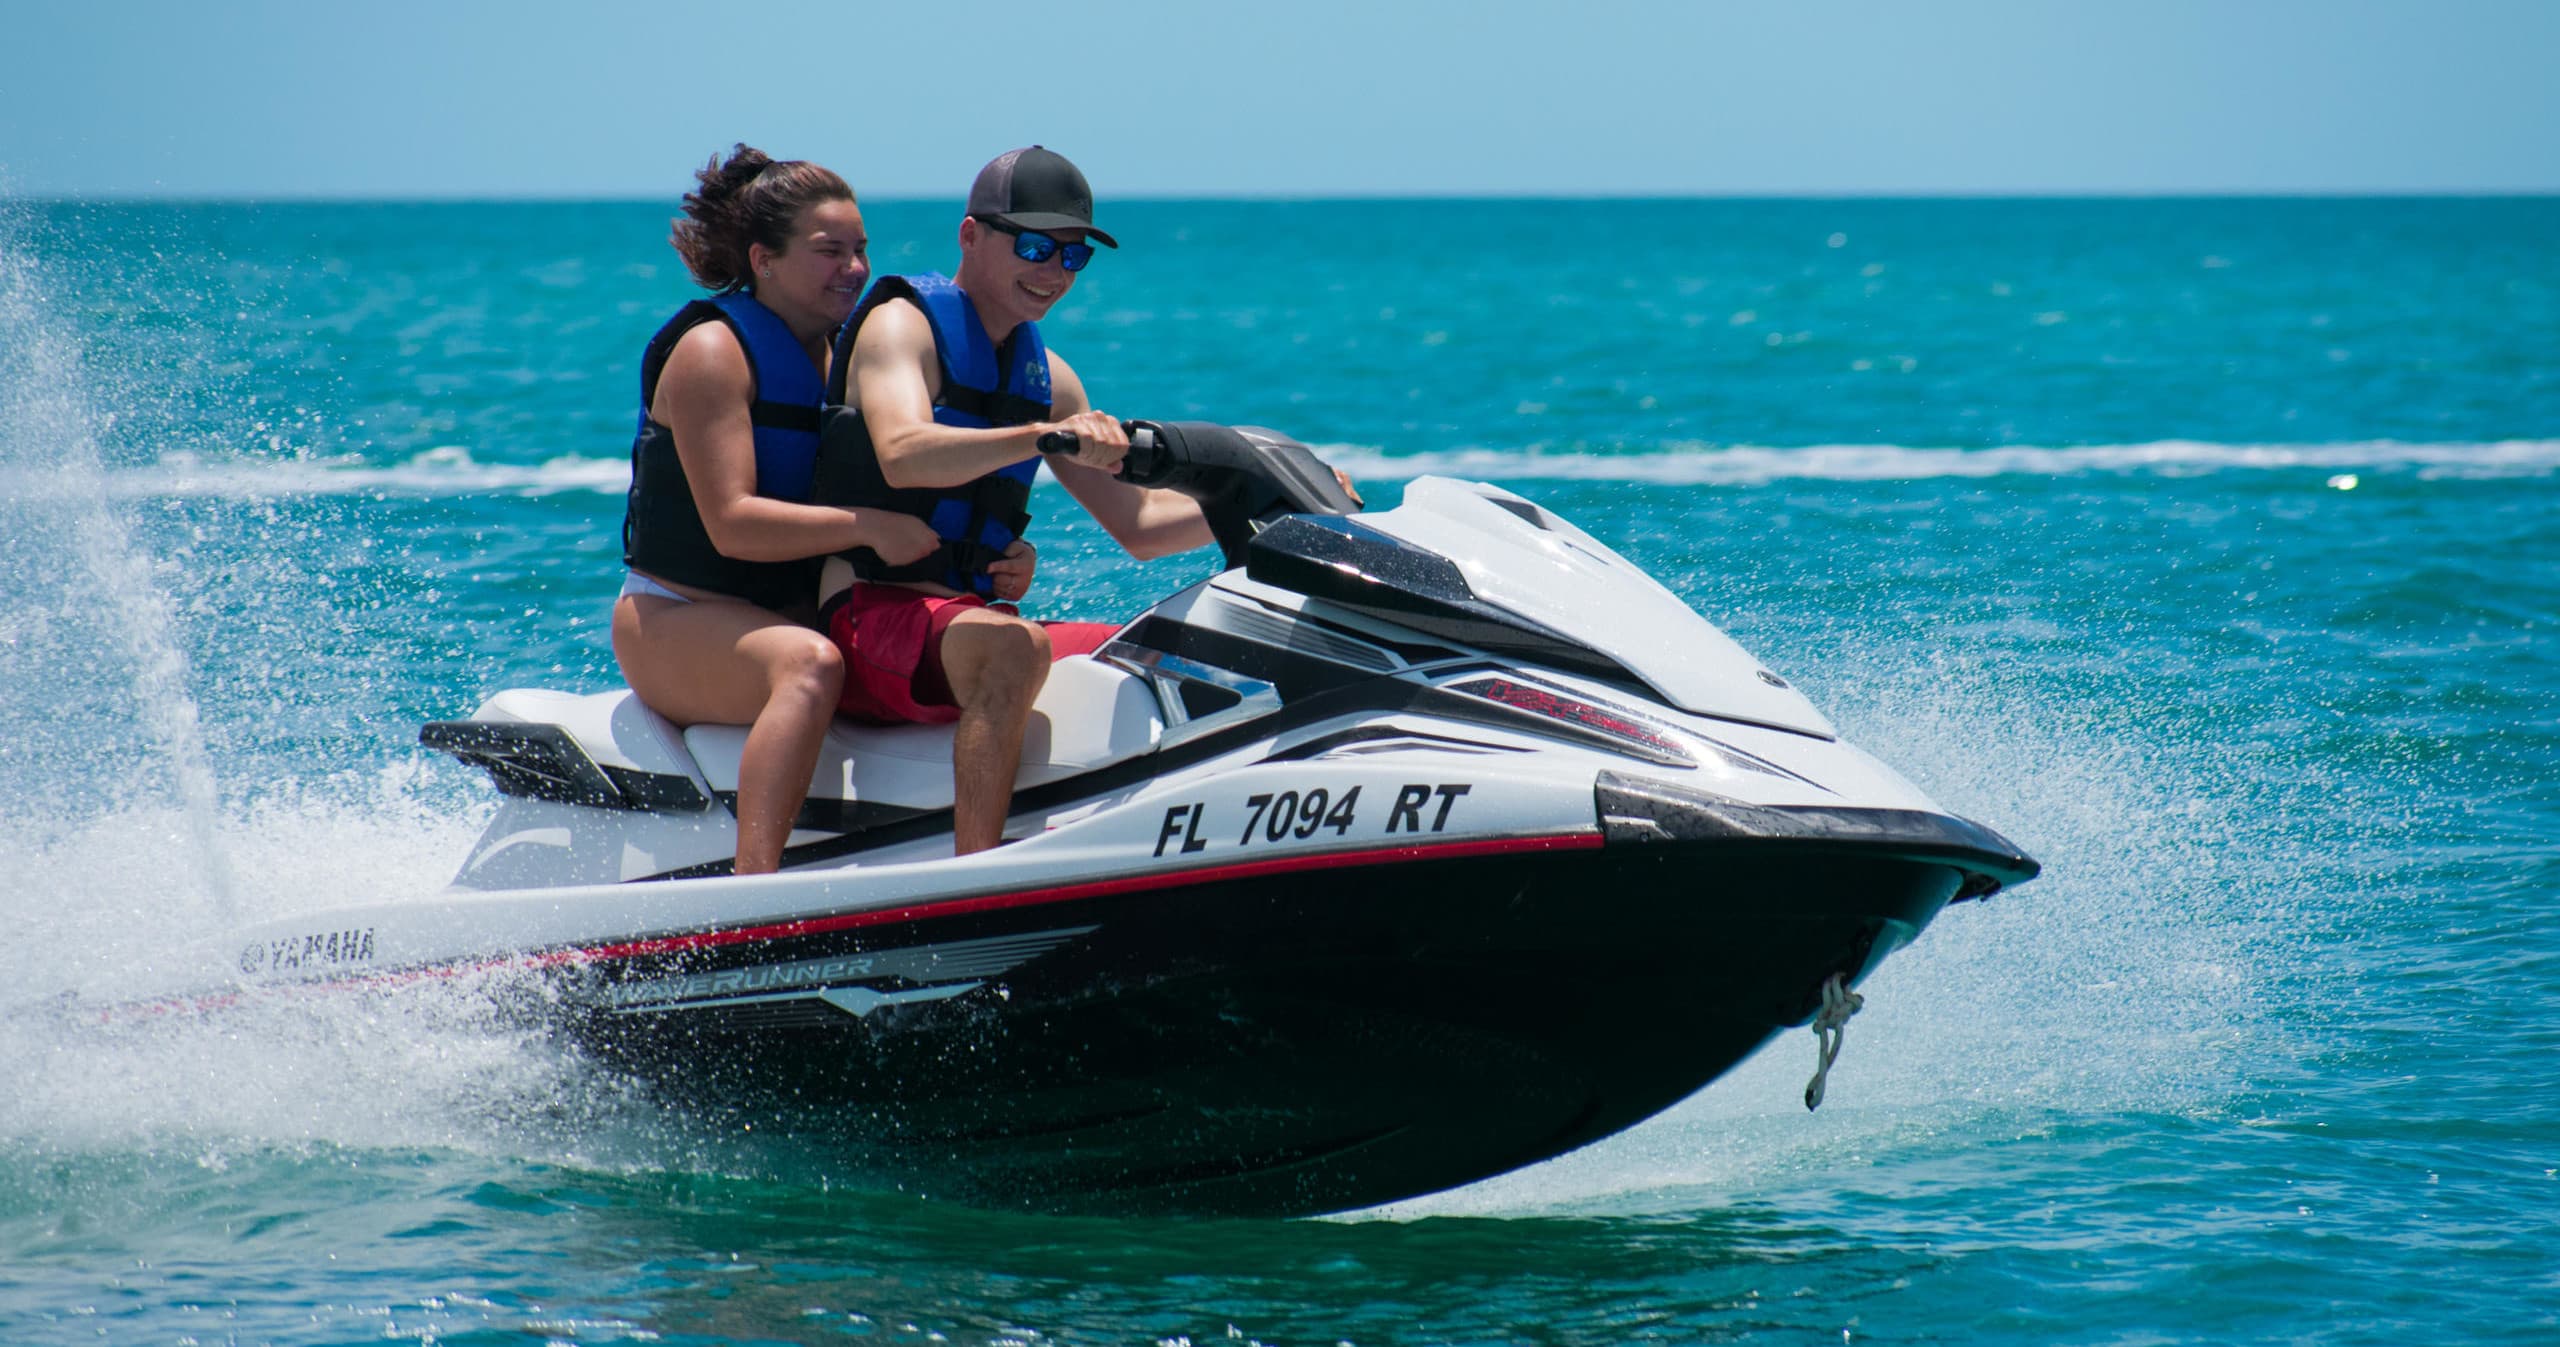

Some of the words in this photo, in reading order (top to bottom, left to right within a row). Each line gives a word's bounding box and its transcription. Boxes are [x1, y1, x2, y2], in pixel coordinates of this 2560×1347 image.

[1153, 803, 1208, 857] FL
[1240, 785, 1362, 846] 7094
[1385, 784, 1472, 833] RT
[271, 927, 374, 970] YAMAHA
